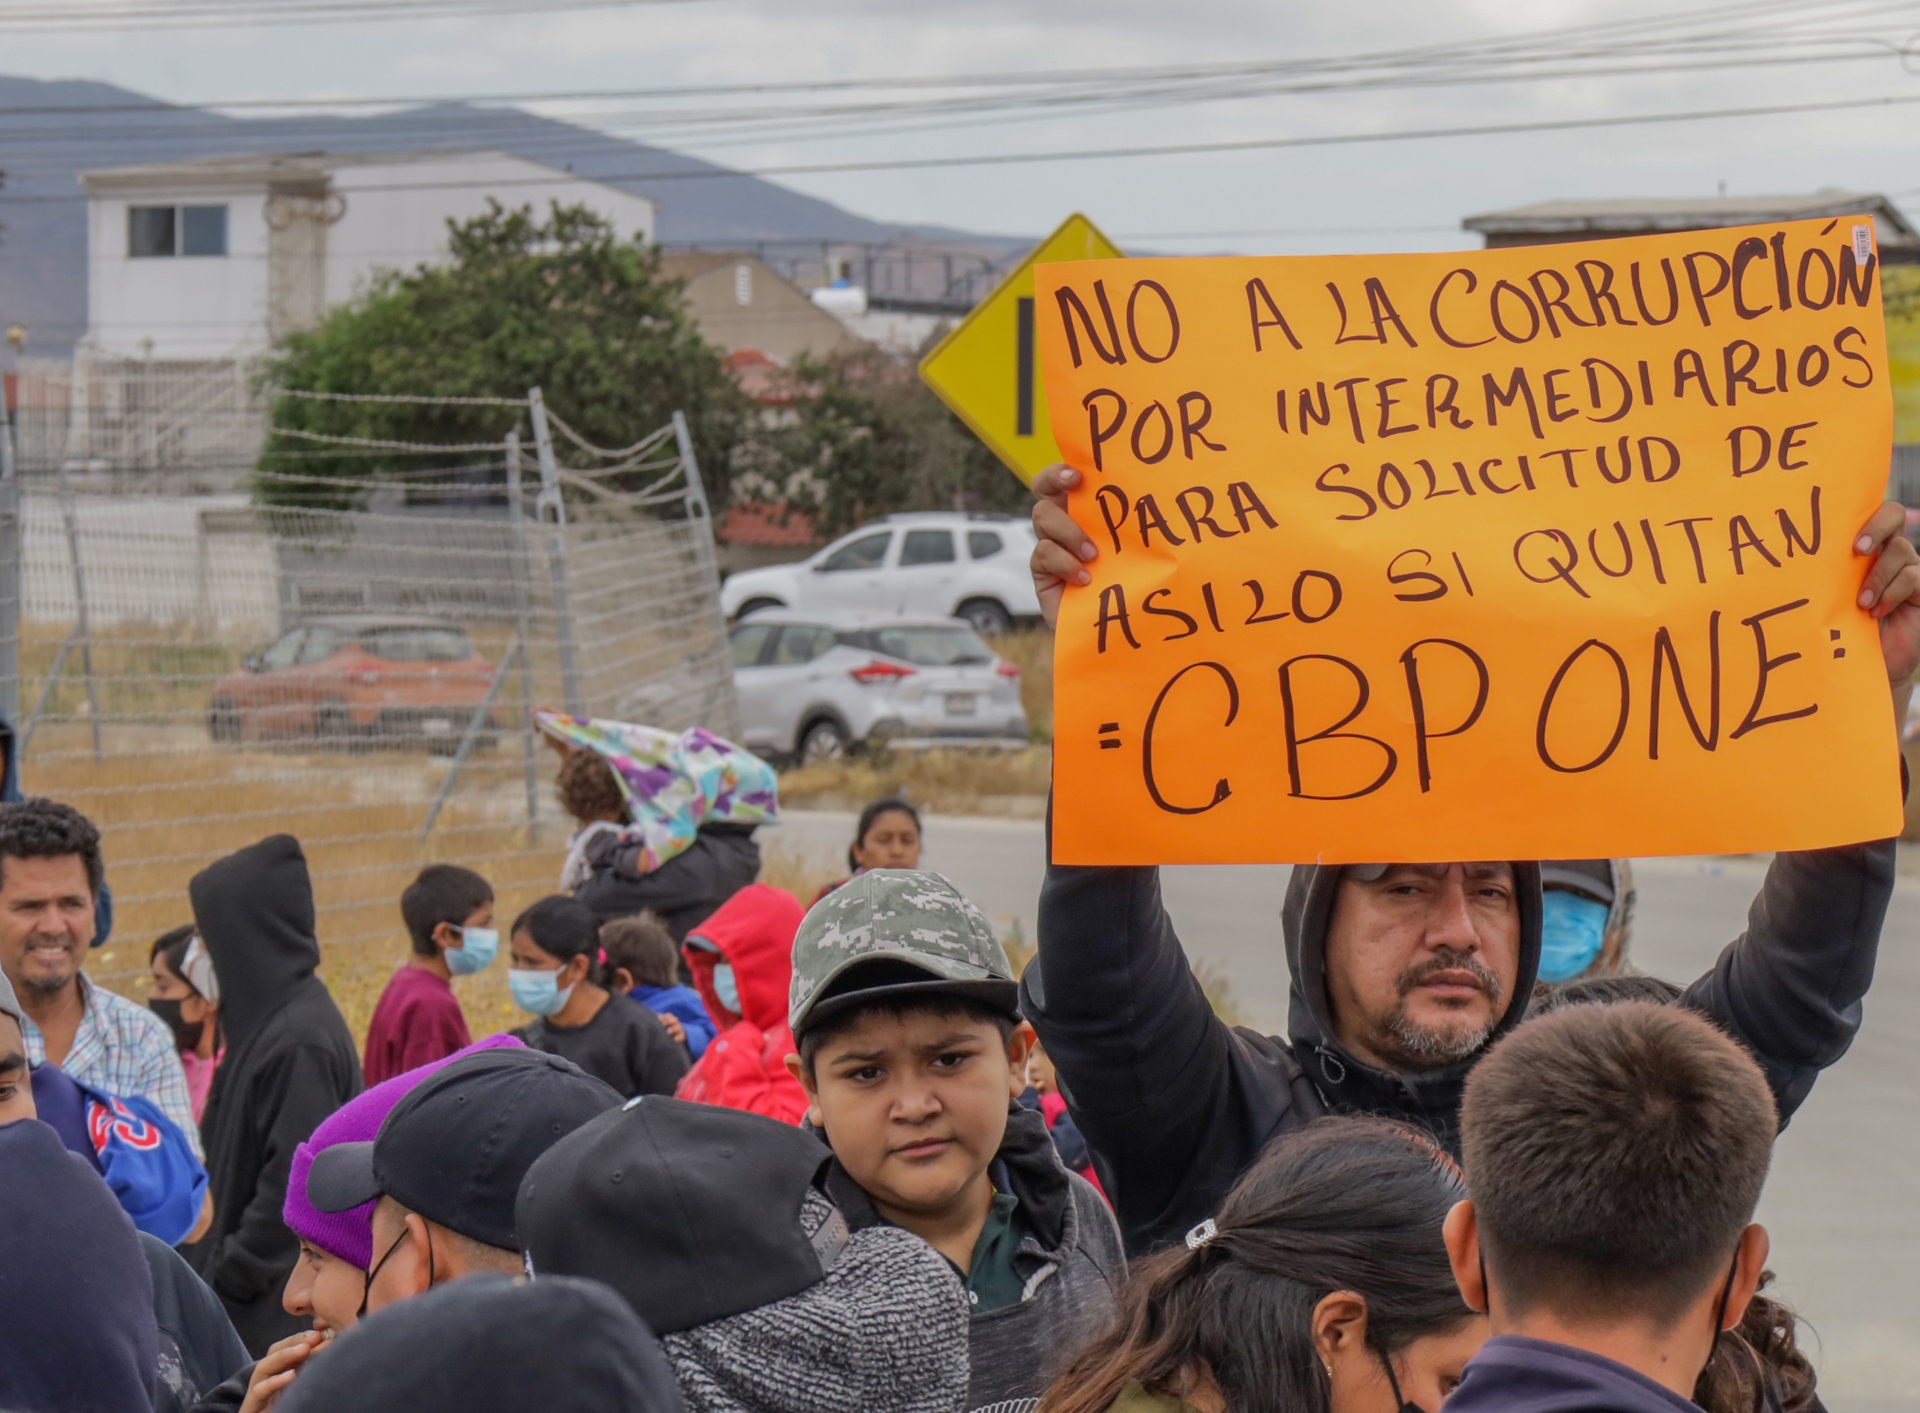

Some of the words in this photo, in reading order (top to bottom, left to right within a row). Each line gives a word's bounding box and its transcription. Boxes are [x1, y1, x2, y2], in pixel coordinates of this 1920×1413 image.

[1054, 279, 1180, 369] NO
[1245, 277, 1303, 352] A
[1325, 277, 1419, 348] LA
[1429, 219, 1877, 348] CORRUPCIÓN
[1082, 387, 1228, 473] POR
[1276, 326, 1873, 445] INTERMEDIARIOS
[1095, 481, 1280, 554] PARA
[1315, 435, 1681, 521] SOLICITUD
[1724, 421, 1819, 478] DE
[1386, 549, 1474, 602] SI
[1513, 485, 1821, 599] QUITAN
